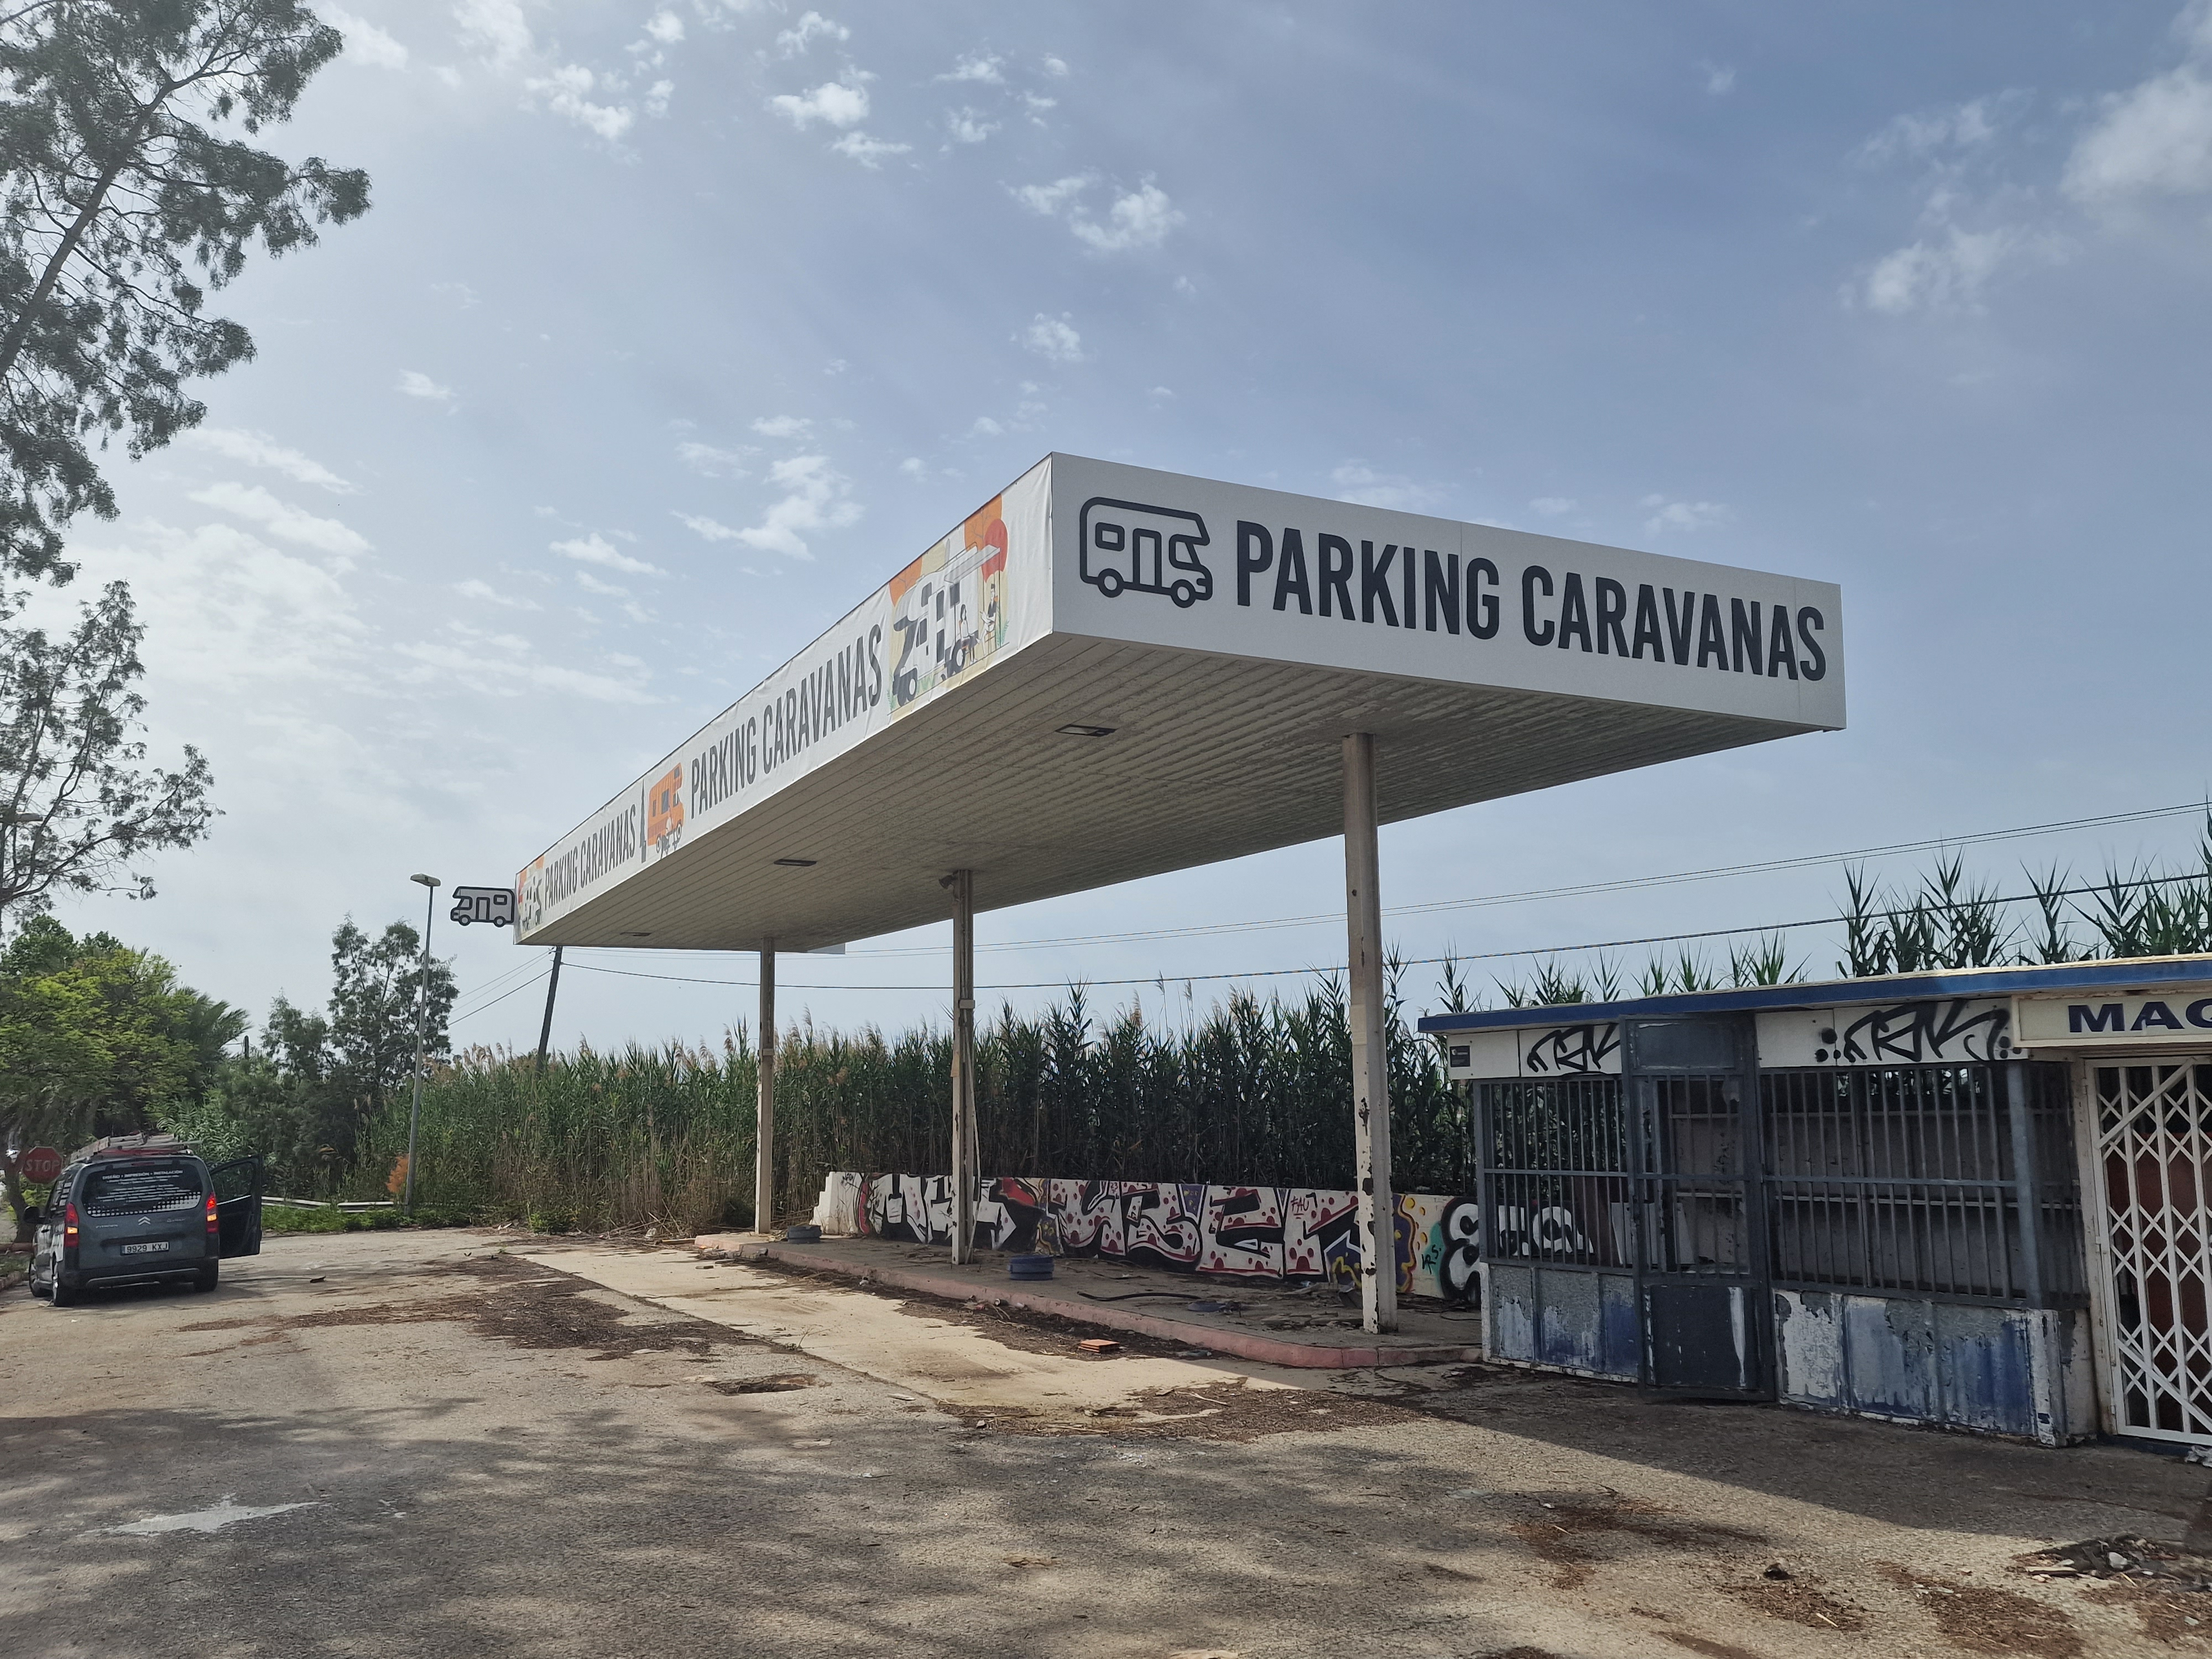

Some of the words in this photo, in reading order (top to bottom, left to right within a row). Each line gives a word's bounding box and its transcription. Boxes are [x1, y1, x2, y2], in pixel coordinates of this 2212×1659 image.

[1237, 520, 1500, 640] PARKING
[1522, 565, 1826, 681] CARAVANAS
[691, 716, 757, 819] PARKING
[763, 624, 882, 774] CARAVANAS
[545, 846, 578, 910] PARKING
[581, 804, 636, 888] CARAVANAS
[24, 1159, 60, 1172] STOP
[127, 1244, 148, 1253] 9929
